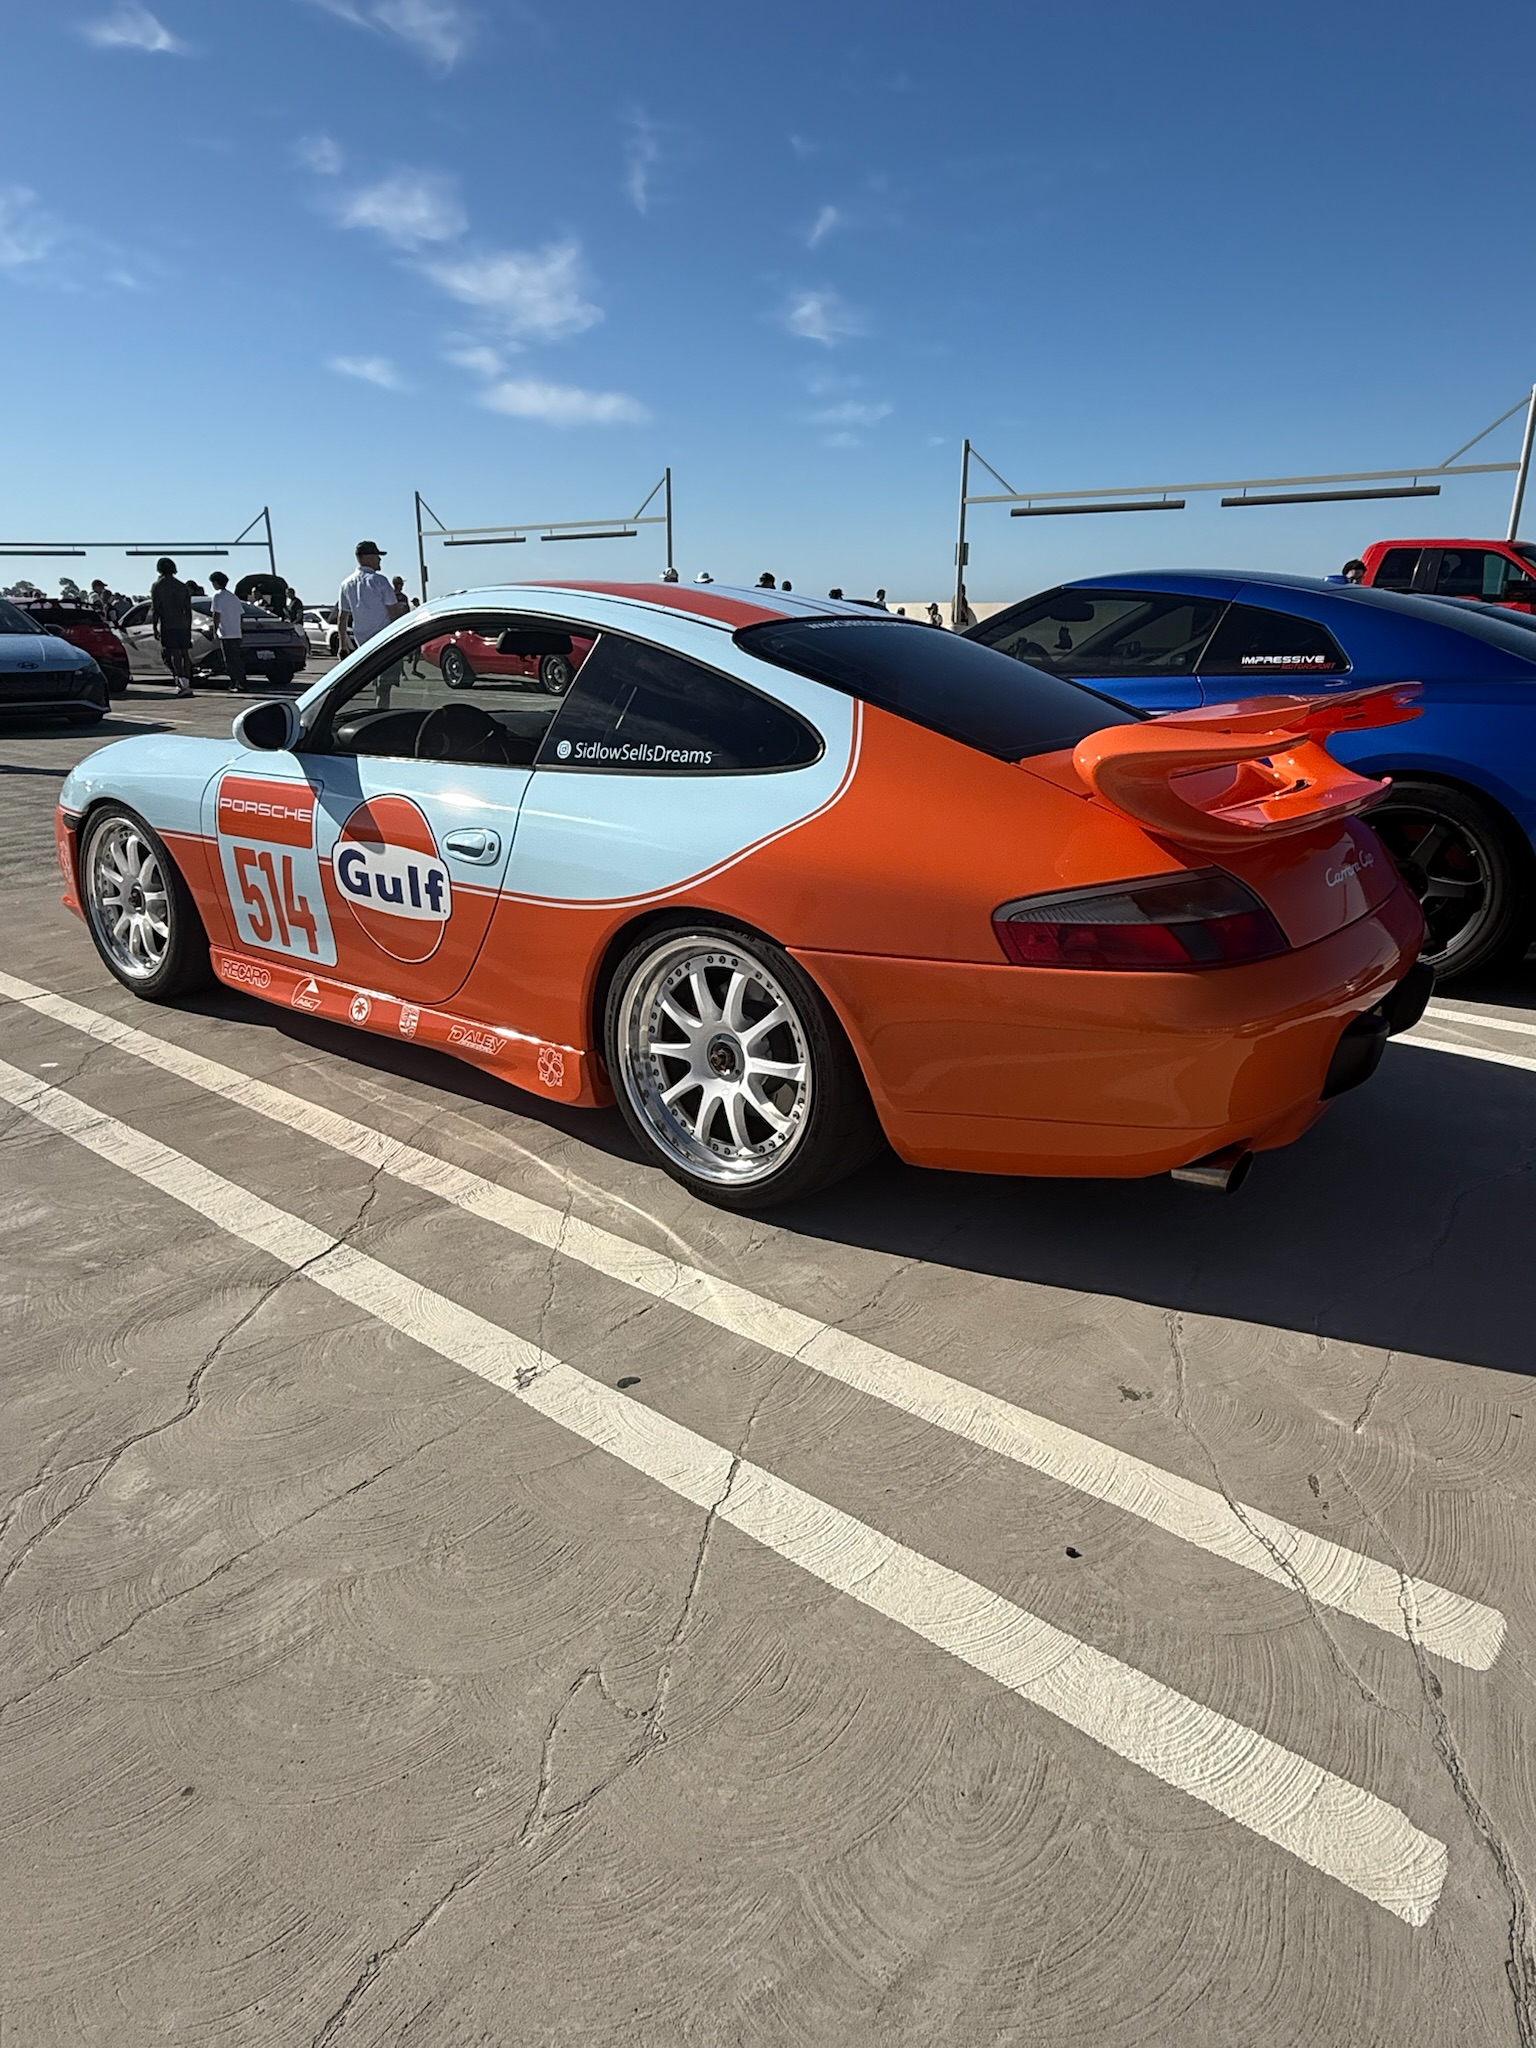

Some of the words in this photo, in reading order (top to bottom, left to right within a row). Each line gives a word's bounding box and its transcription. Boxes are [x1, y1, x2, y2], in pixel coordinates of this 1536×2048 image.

[1241, 655, 1326, 664] IMPRESSIVE
[1281, 662, 1336, 670] MOTORSPORT
[574, 741, 713, 764] SidlowSellsDreams
[220, 797, 312, 823] PORSCHE
[338, 849, 444, 913] Gulf
[233, 846, 319, 954] 514
[221, 958, 271, 988] RECARO
[446, 1025, 507, 1055] DALEY
